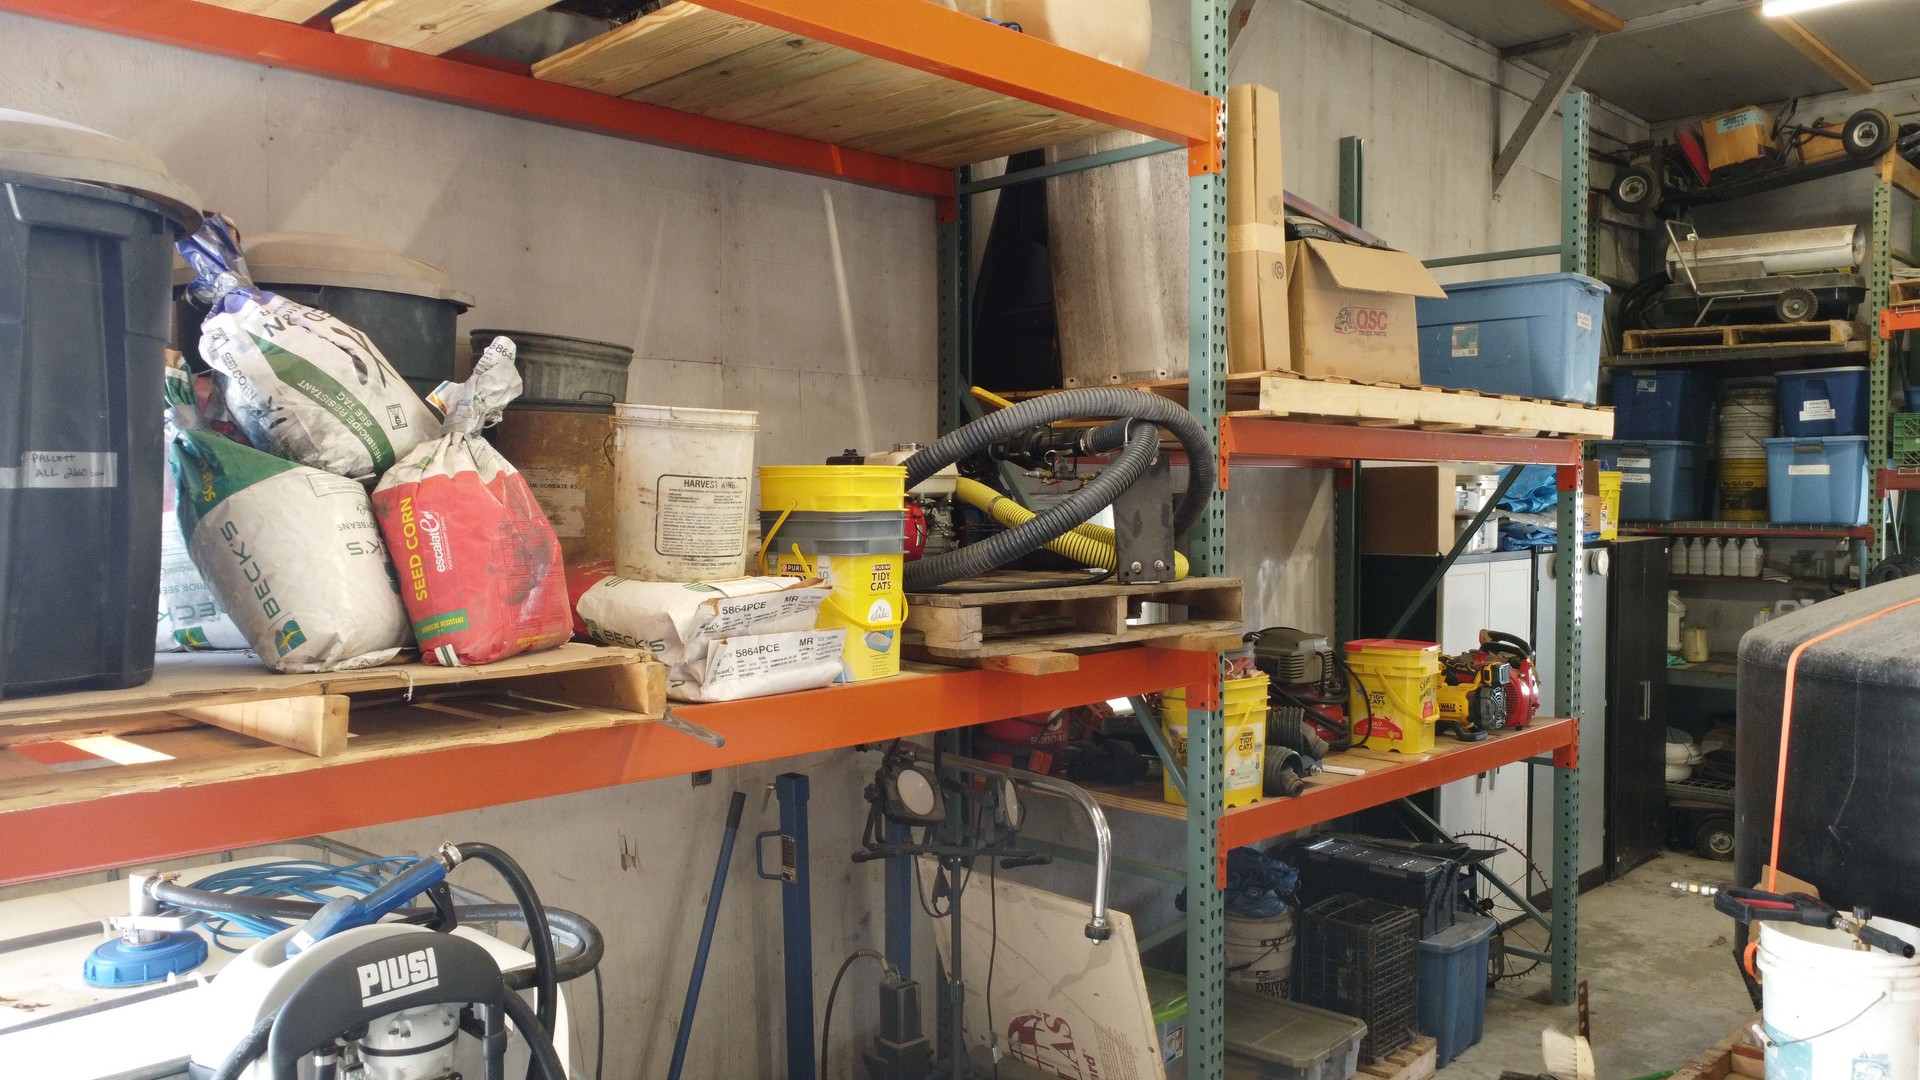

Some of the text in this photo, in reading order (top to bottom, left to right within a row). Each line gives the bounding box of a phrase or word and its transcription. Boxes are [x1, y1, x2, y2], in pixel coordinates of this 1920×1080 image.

[1356, 309, 1388, 331] QSC
[221, 351, 258, 401] SEED CORN
[297, 379, 349, 419] RESISTANT
[336, 391, 375, 428] SEE TAG
[347, 416, 382, 463] HERBICIDE
[683, 479, 718, 489] HARVEST
[400, 496, 428, 602] SEED CORN
[419, 510, 446, 573] escalate
[219, 519, 282, 621] BECK'S
[871, 571, 891, 581] TIDY
[870, 581, 891, 592] CATS
[722, 601, 767, 615] 5864PCE
[784, 595, 799, 603] MR
[603, 629, 666, 653] BECK'S
[735, 643, 780, 658] 5864PCE
[799, 637, 814, 647] MR
[1238, 742, 1254, 752] CATS
[1239, 736, 1253, 744] TIDY
[357, 947, 438, 999] PIUSI
